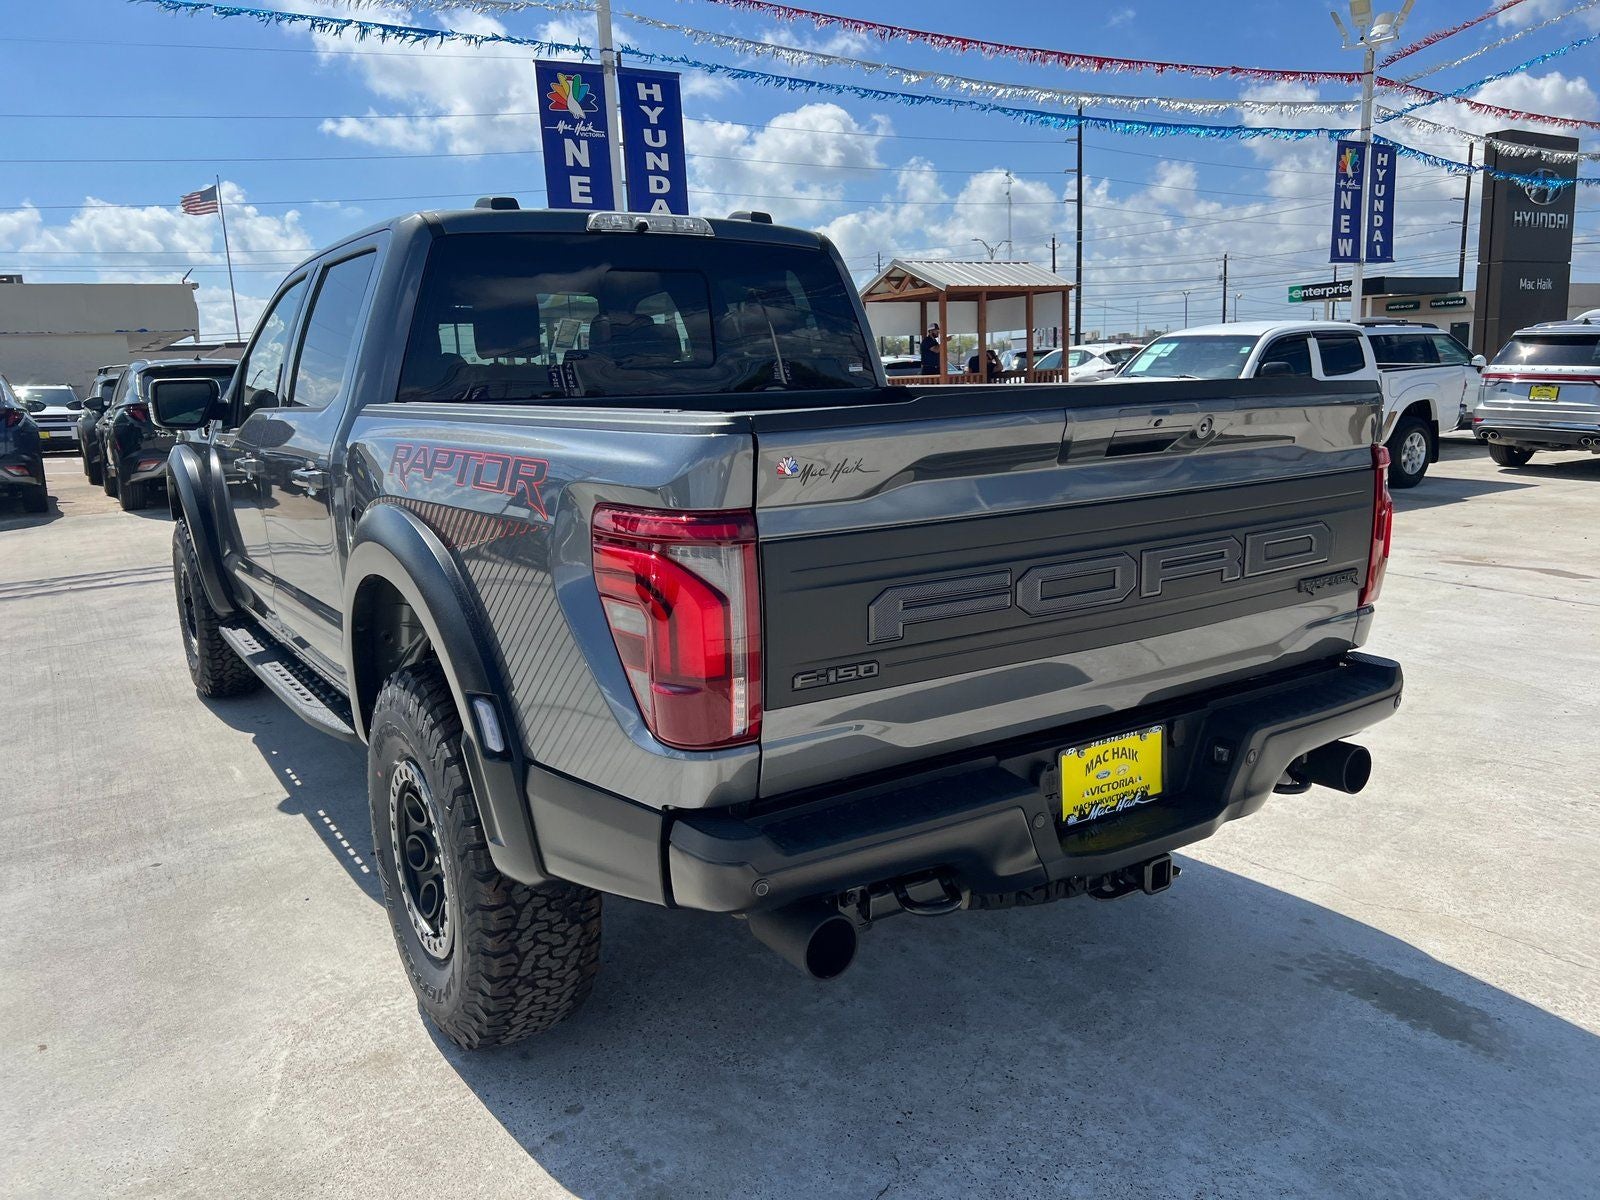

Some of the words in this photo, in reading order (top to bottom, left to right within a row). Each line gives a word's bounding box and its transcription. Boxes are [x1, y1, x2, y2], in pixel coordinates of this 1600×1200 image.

[1372, 153, 1389, 257] HYUNDAI
[1513, 210, 1569, 229] HYUNDAI
[1337, 191, 1353, 257] NEW
[1519, 278, 1536, 290] Mac
[1536, 278, 1553, 290] Haik
[388, 443, 549, 521] RAPTOR
[829, 457, 880, 483] Haik
[866, 519, 1333, 646] FORD
[793, 660, 879, 691] F-150
[1085, 749, 1109, 776] MAC
[1112, 746, 1139, 763] HAIK
[1089, 776, 1135, 797] VICTORIA
[1115, 792, 1158, 812] Haik
